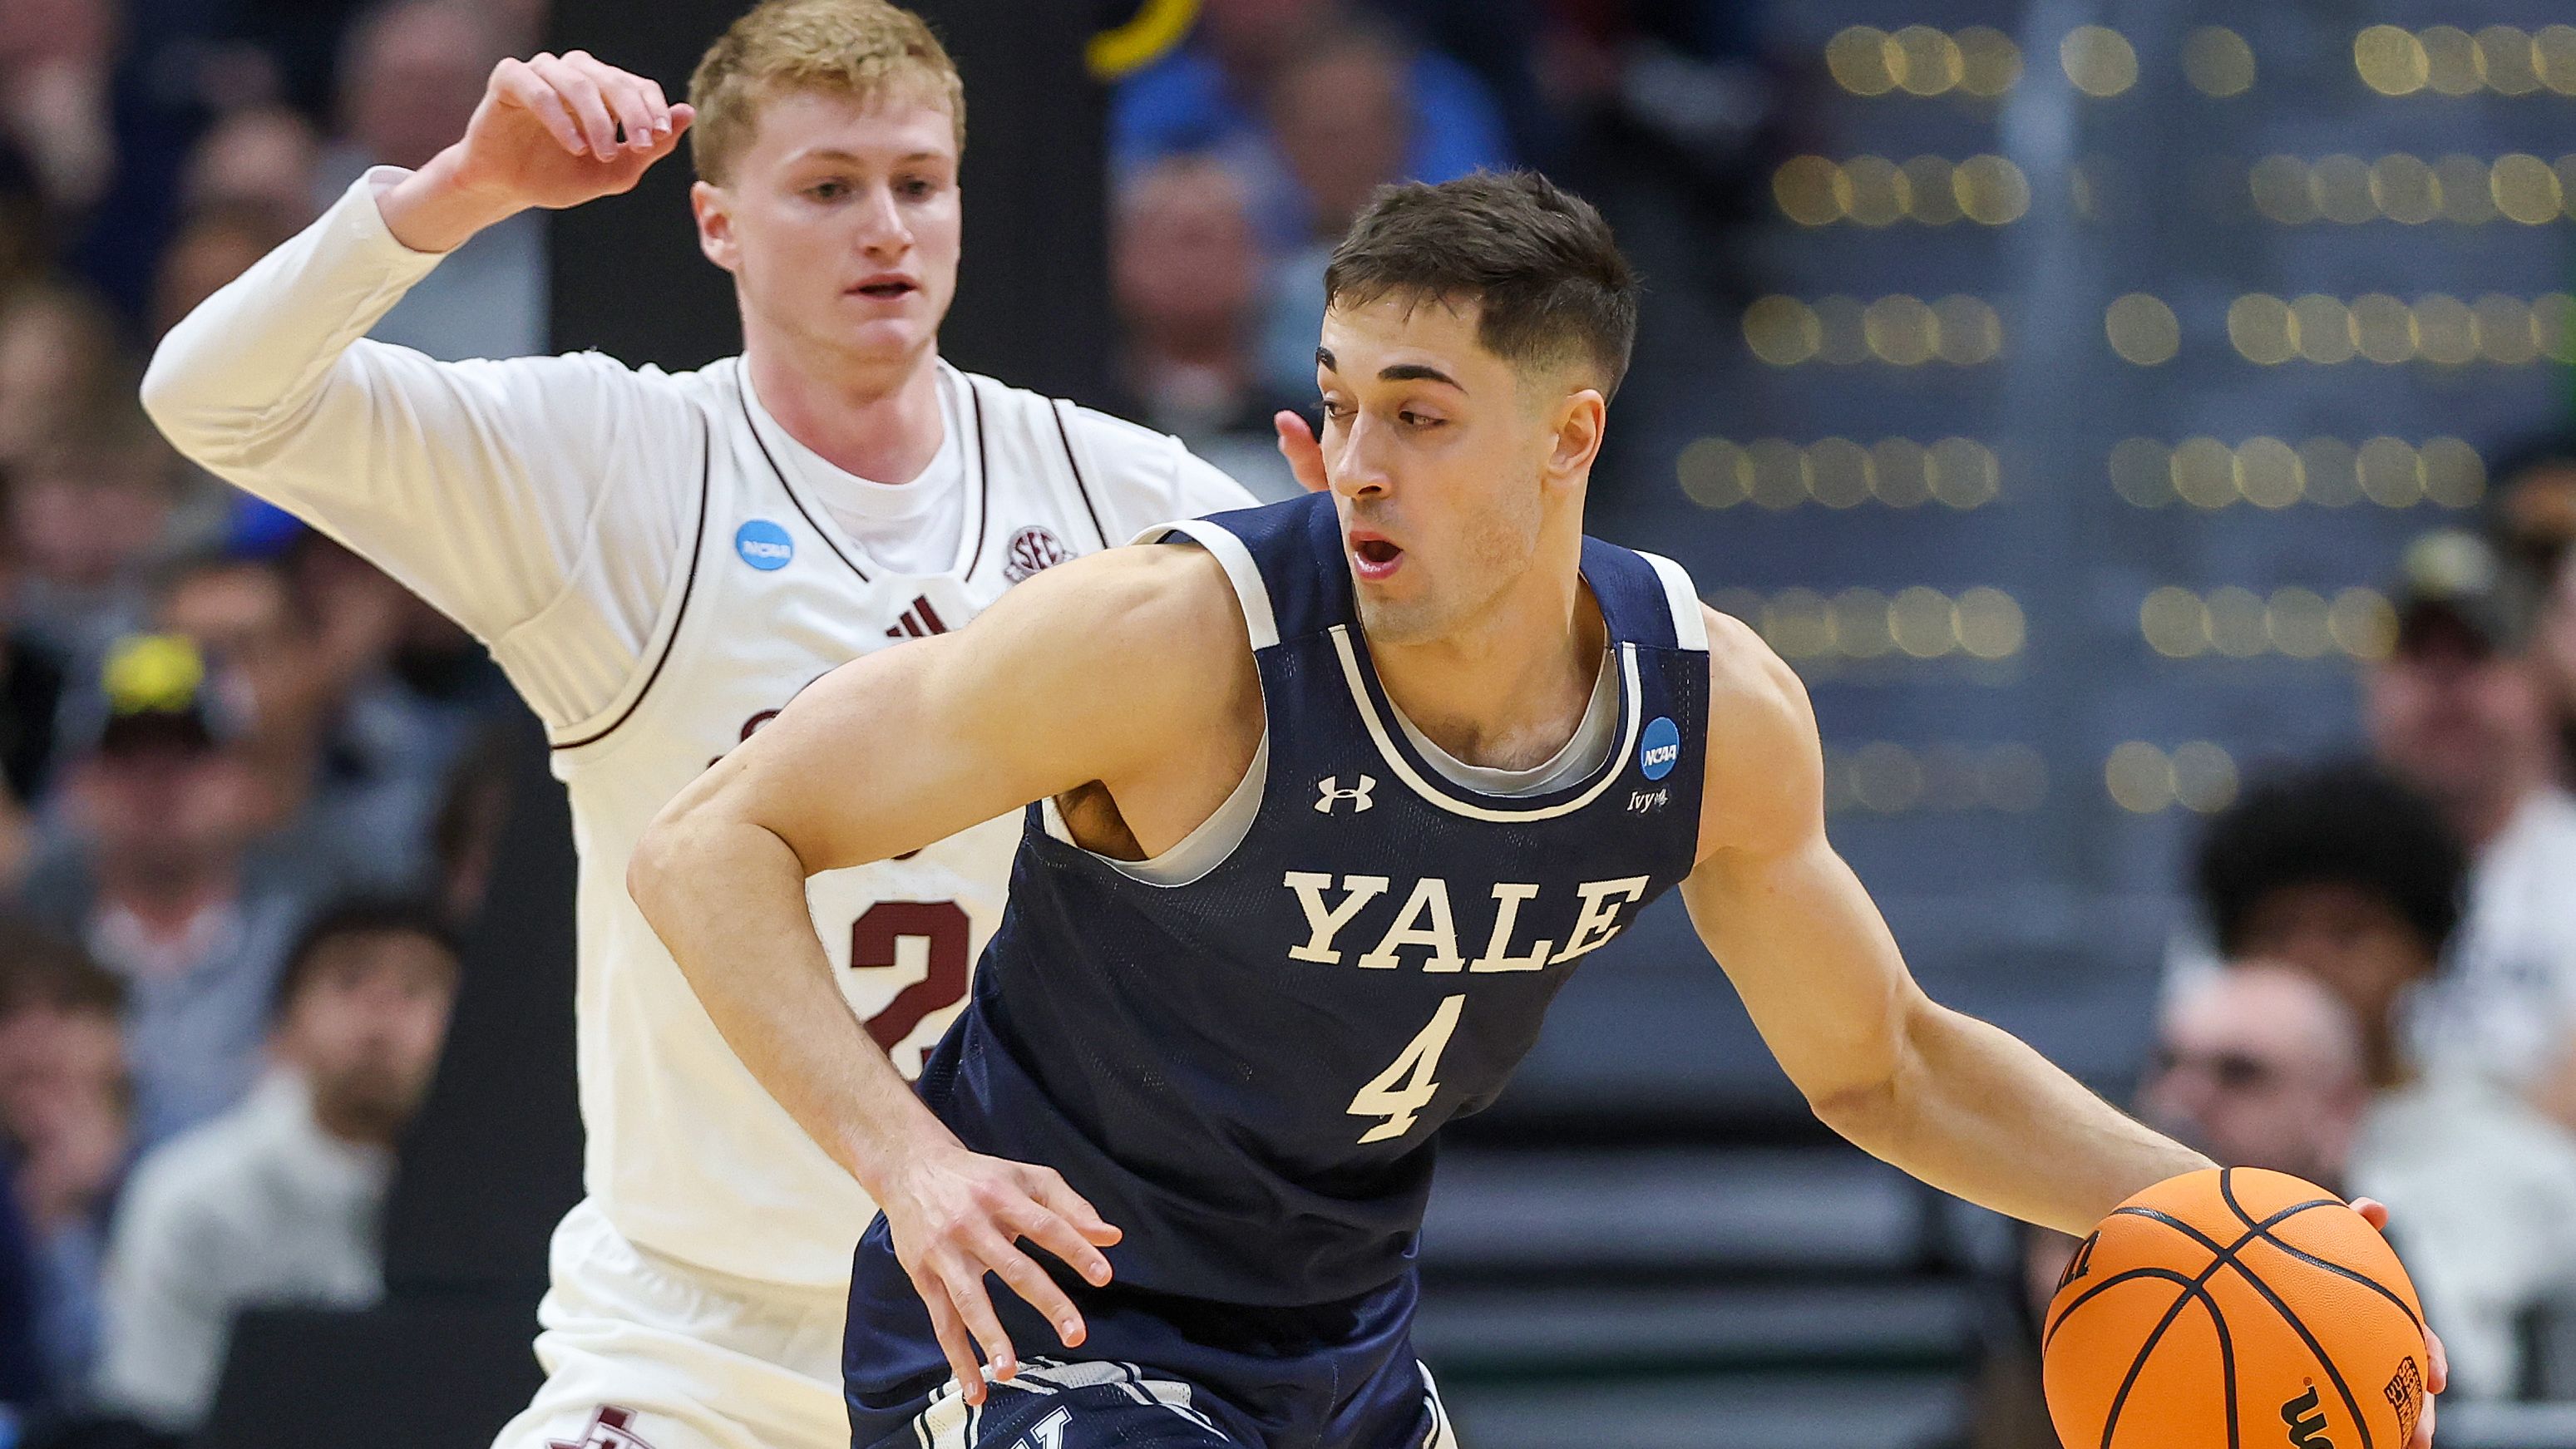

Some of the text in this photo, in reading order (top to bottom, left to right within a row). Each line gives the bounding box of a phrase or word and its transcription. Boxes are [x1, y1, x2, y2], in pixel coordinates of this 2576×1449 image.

[1014, 530, 1058, 570] SEC
[1644, 744, 1677, 766] NCAA
[1626, 791, 1656, 814] Ivy
[1283, 870, 1651, 973] YALE
[850, 899, 970, 1092] 2
[1345, 993, 1467, 1146] 4
